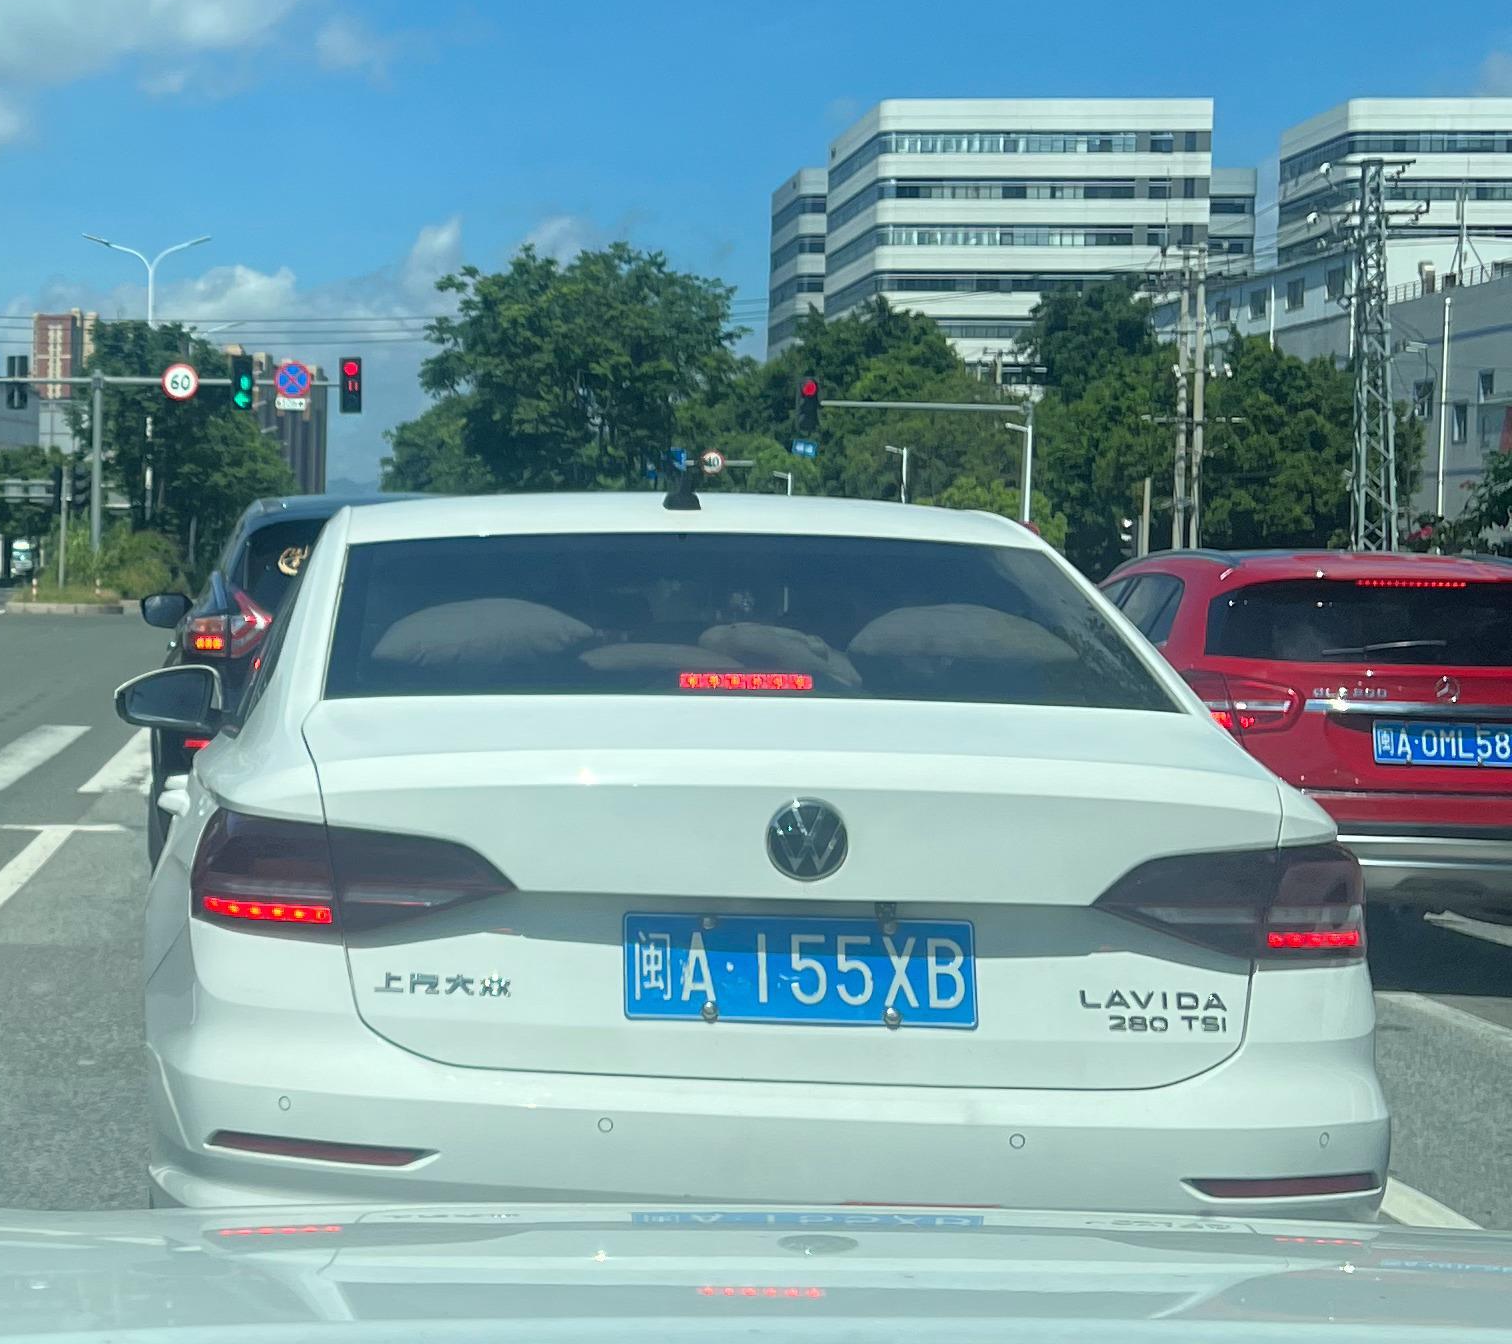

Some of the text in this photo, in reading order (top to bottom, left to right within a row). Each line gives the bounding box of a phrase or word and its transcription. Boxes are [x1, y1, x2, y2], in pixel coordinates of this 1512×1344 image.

[170, 374, 191, 391] 60
[374, 971, 511, 997] 上汽大众
[1079, 989, 1227, 1011] LAVIDA
[1109, 1015, 1227, 1032] 280 TSI
